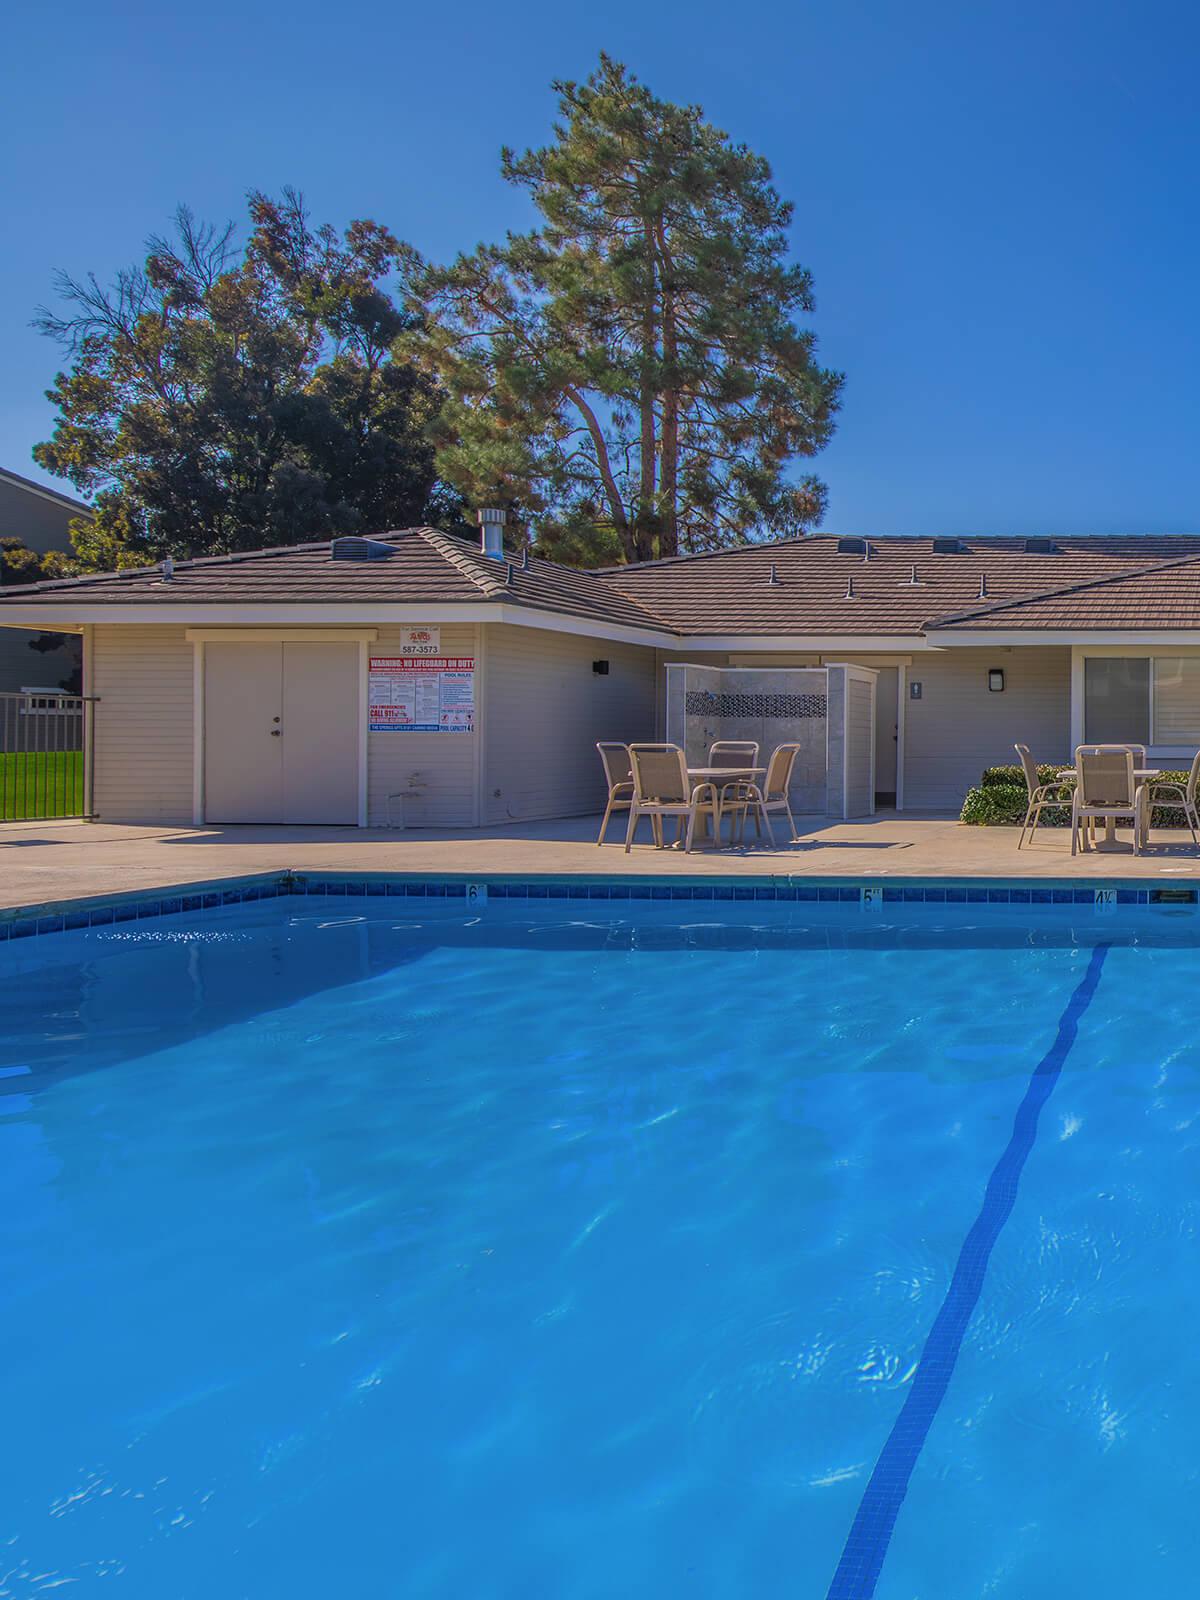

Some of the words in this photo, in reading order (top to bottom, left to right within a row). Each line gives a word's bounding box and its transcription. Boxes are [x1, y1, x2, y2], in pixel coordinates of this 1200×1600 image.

[413, 660, 447, 668] LIFEGUARD
[448, 660, 457, 668] ON
[458, 660, 475, 668] DUTY
[370, 709, 383, 717] CALL
[384, 709, 394, 717] 911
